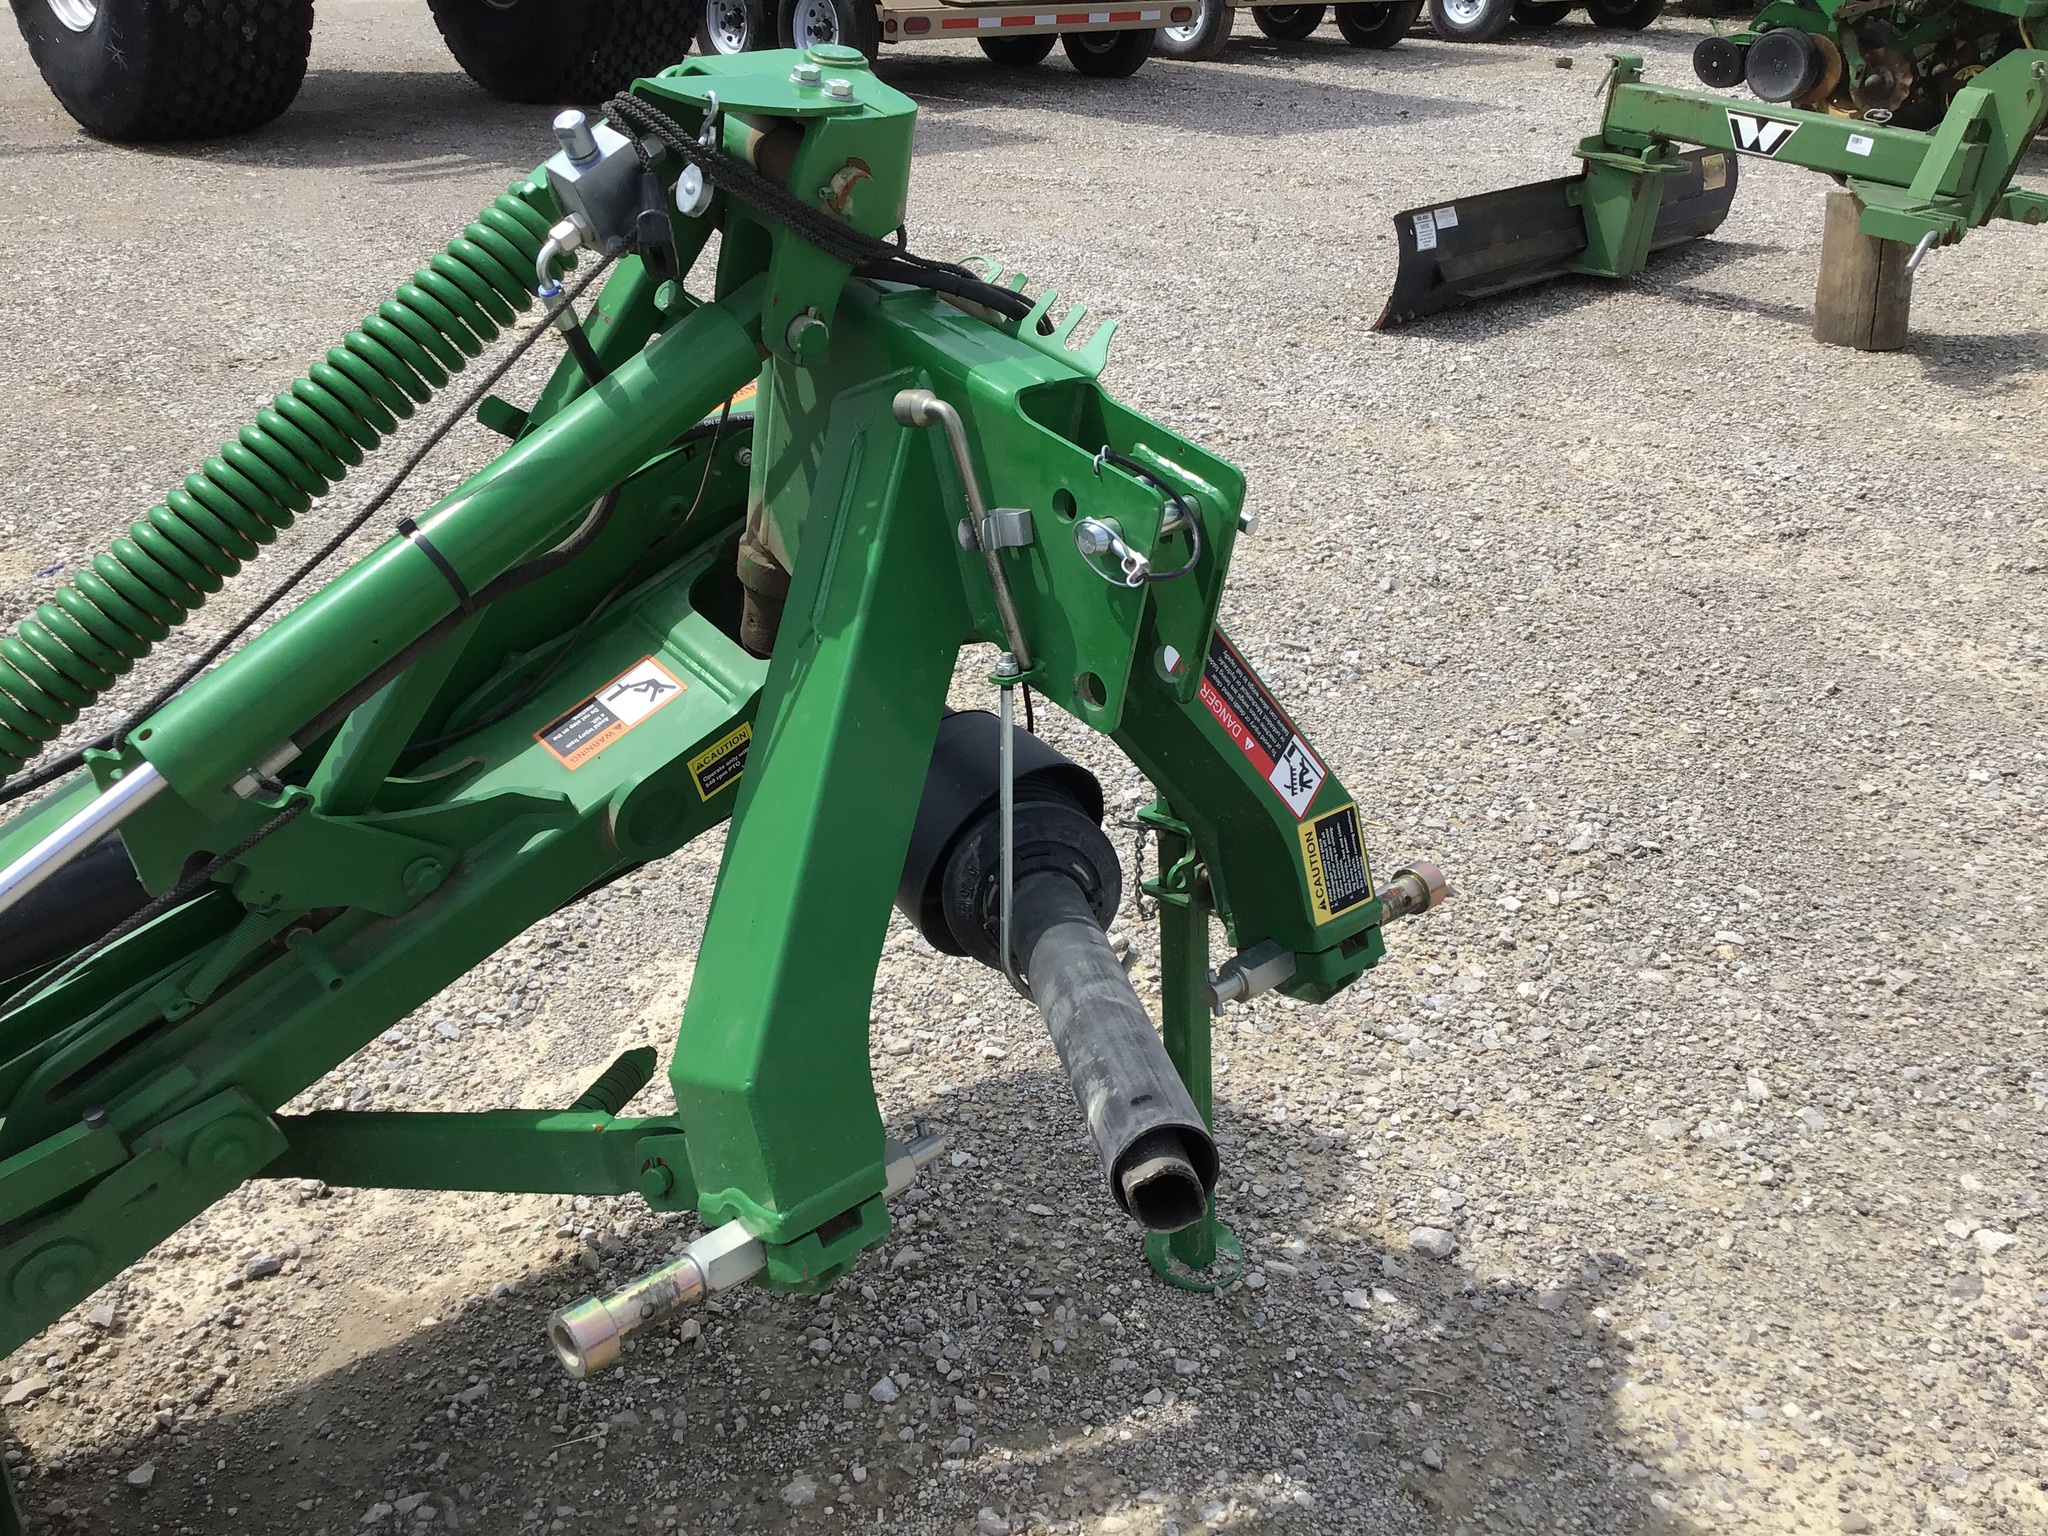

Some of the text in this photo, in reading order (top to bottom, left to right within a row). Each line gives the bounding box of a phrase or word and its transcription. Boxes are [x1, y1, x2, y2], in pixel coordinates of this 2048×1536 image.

[1216, 654, 1237, 681] hydraulic
[1235, 667, 1243, 678] fall
[1210, 672, 1222, 689] clear
[1217, 668, 1231, 686] being
[1220, 685, 1234, 703] stand
[1229, 683, 1238, 695] are
[1246, 679, 1260, 698] wings
[1232, 699, 1245, 718] death
[1236, 691, 1250, 710] wings
[1239, 685, 1263, 715] Mechanical
[1257, 695, 1269, 711] allow
[570, 703, 595, 722] machine.
[580, 712, 591, 721] not
[589, 707, 599, 715] Do
[1198, 681, 1242, 738] DANGER
[1248, 707, 1260, 723] when
[1268, 708, 1277, 721] can
[567, 718, 582, 729] step
[589, 715, 601, 725] fall.
[1248, 719, 1262, 737] injury
[1276, 718, 1289, 736] failure
[551, 732, 563, 741] the
[564, 716, 610, 748] Avoid injury from
[1258, 720, 1277, 745] machine
[569, 730, 615, 763] WARNING
[702, 730, 747, 765] CAUTION
[1259, 733, 1272, 750] avoid
[702, 763, 725, 782] Operate
[725, 754, 738, 766] only
[704, 760, 741, 788] 540 rpm PTO
[1304, 830, 1324, 899] CAUTION
